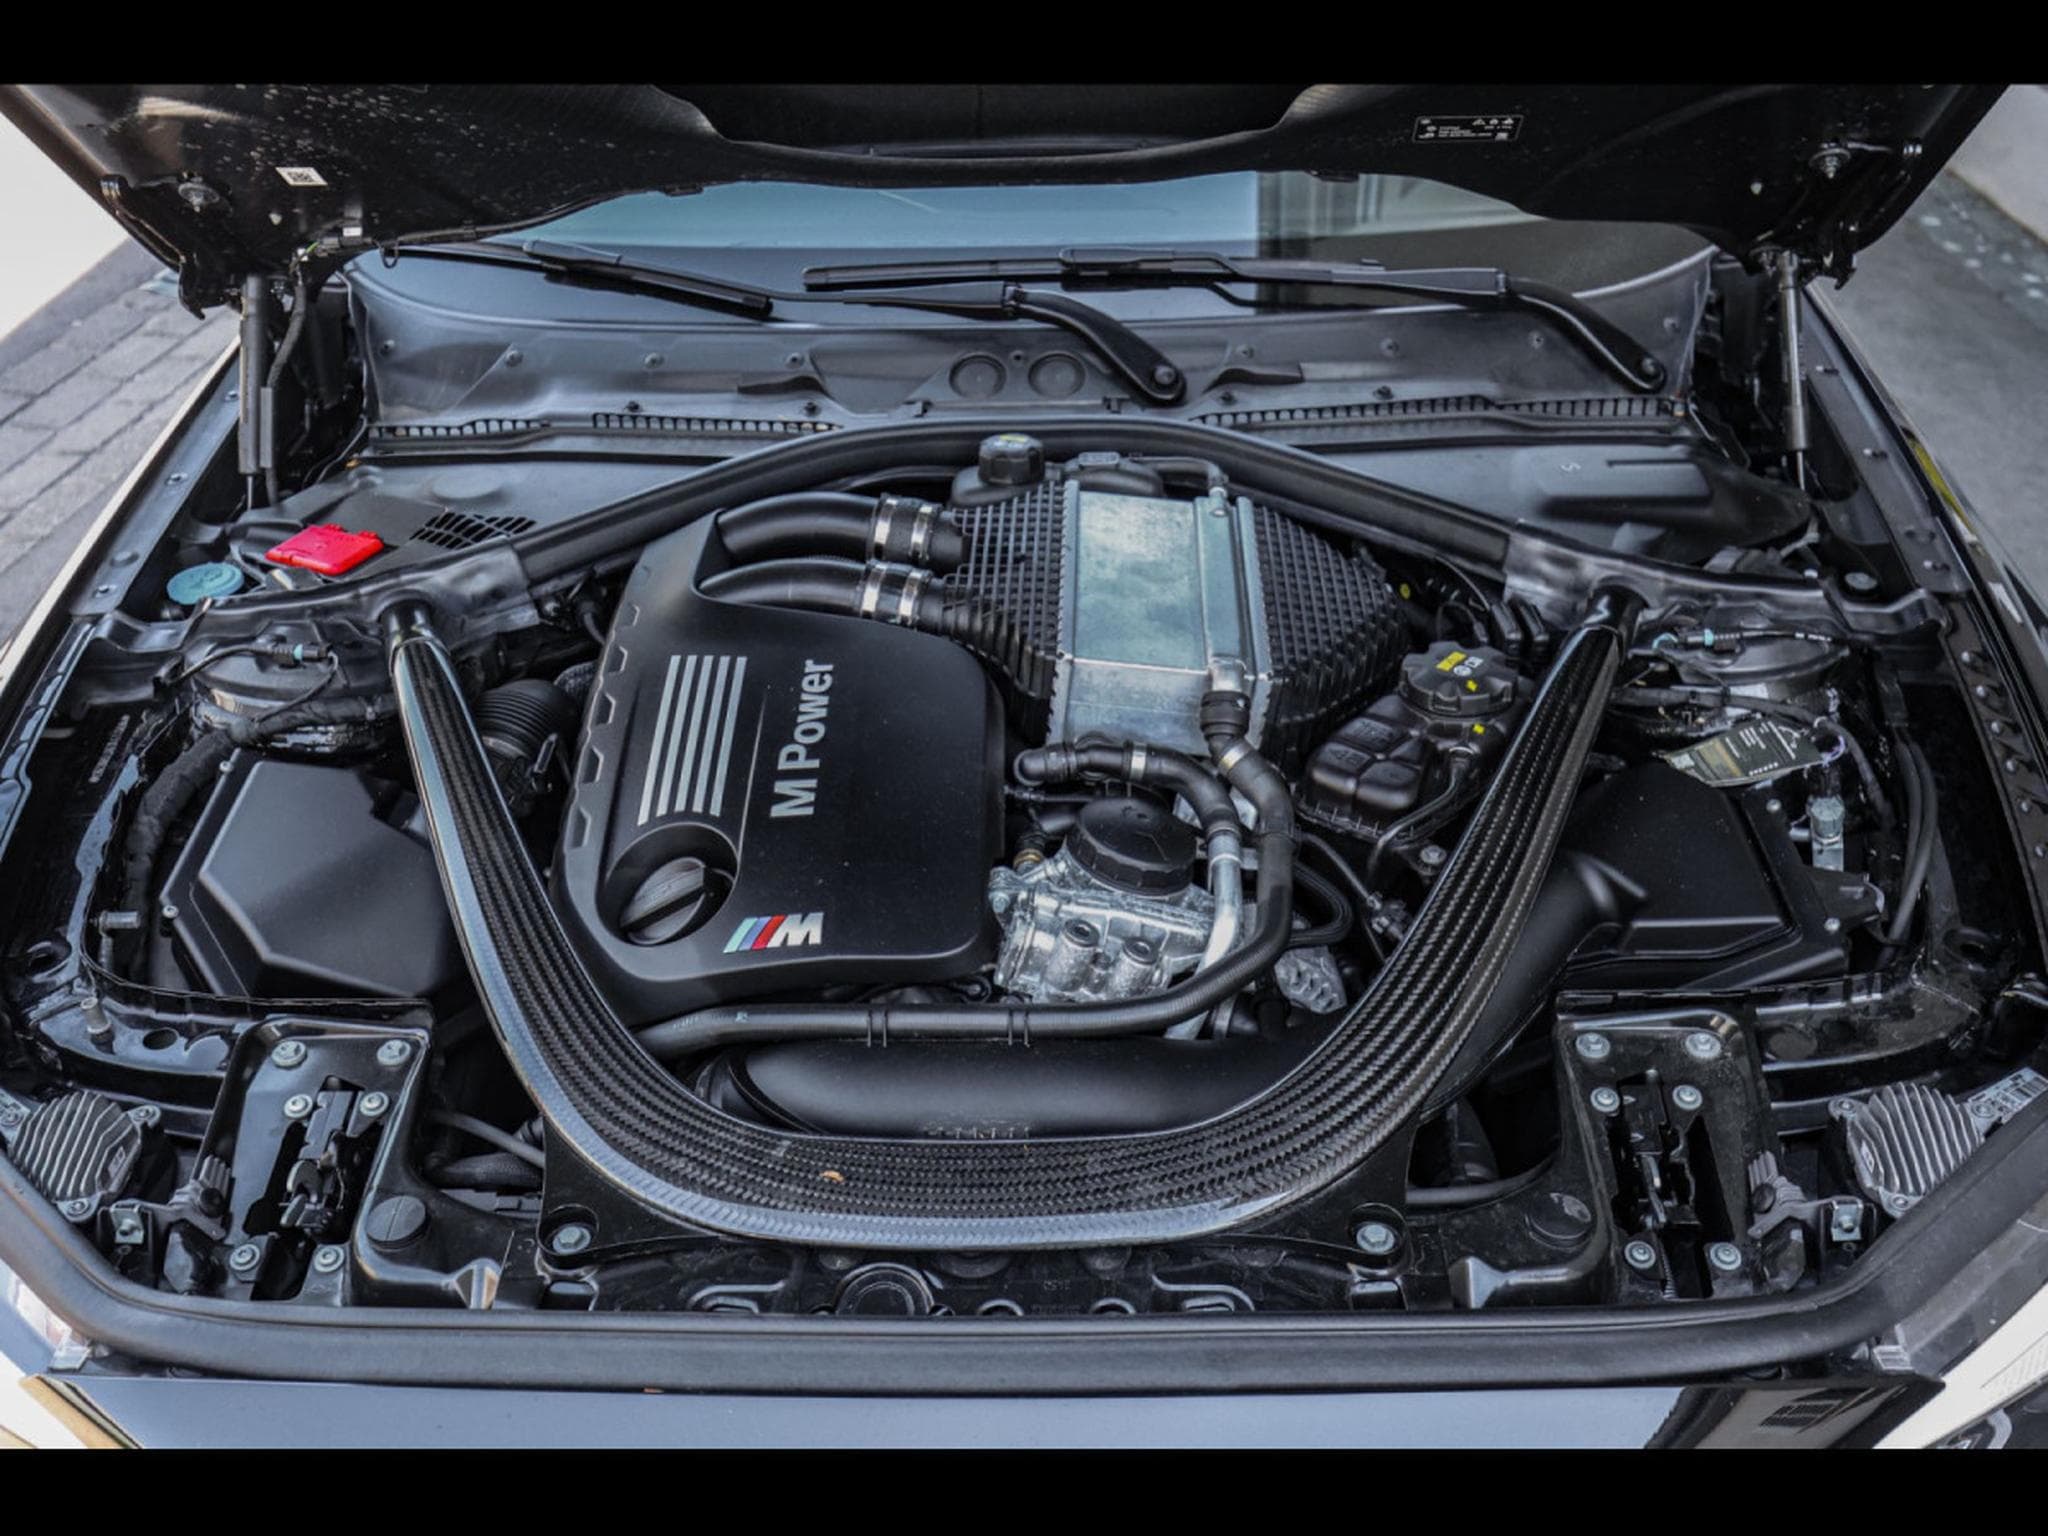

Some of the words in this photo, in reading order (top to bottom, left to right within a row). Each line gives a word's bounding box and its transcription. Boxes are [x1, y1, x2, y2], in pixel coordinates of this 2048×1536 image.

[777, 658, 835, 771] Power
[769, 778, 819, 819] M
[765, 911, 825, 949] M
